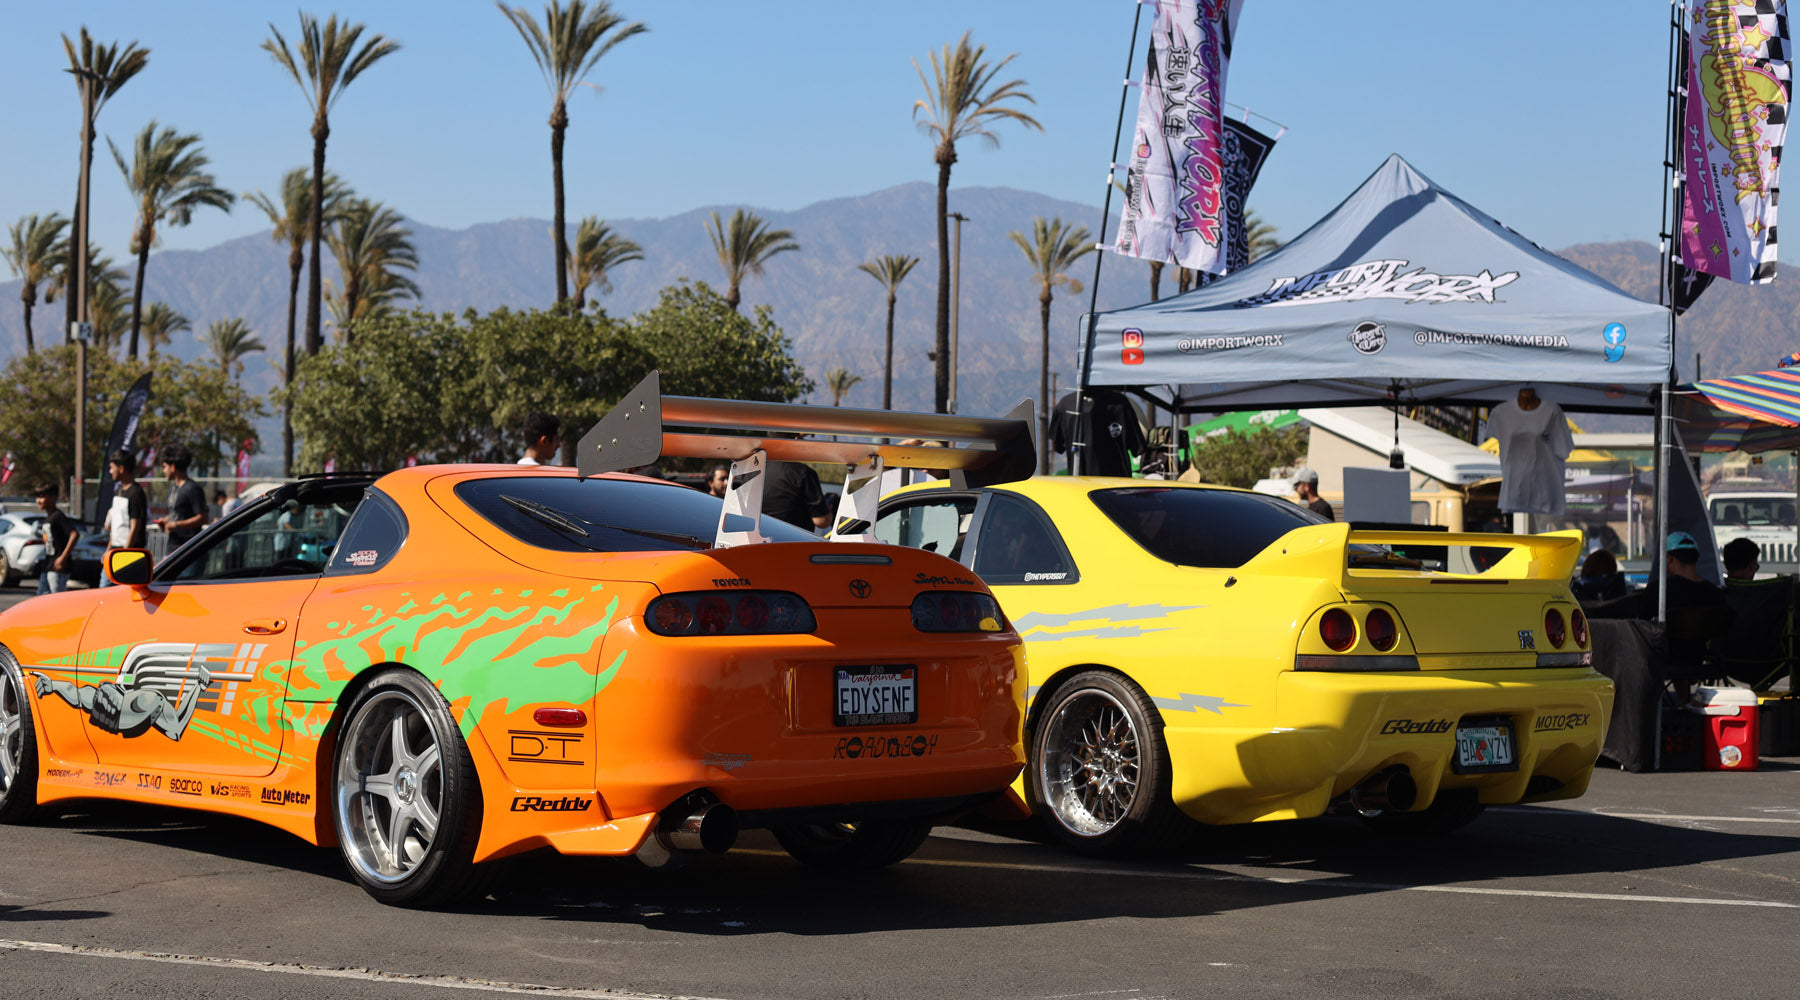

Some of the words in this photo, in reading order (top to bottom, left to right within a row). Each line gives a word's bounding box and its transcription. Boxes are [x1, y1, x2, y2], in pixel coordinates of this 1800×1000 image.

[1161, 46, 1191, 139] 速い人生
[1688, 124, 1714, 215] ナイトレース
[1711, 162, 1732, 239] IMPORTWORX.COM
[1266, 259, 1409, 296] IMPORT
[1347, 266, 1521, 305] WORX
[1177, 334, 1284, 352] @IMPORTWORX
[1414, 331, 1569, 349] @IMPORTWORXMEDIA
[712, 578, 751, 588] TOYOTA
[840, 686, 911, 714] EDYSFNF
[1380, 719, 1454, 735] GReddy
[1536, 713, 1590, 730] MOTOREX
[1488, 737, 1508, 761] YZY
[170, 778, 203, 792] sparco
[510, 797, 593, 812] GReddy
